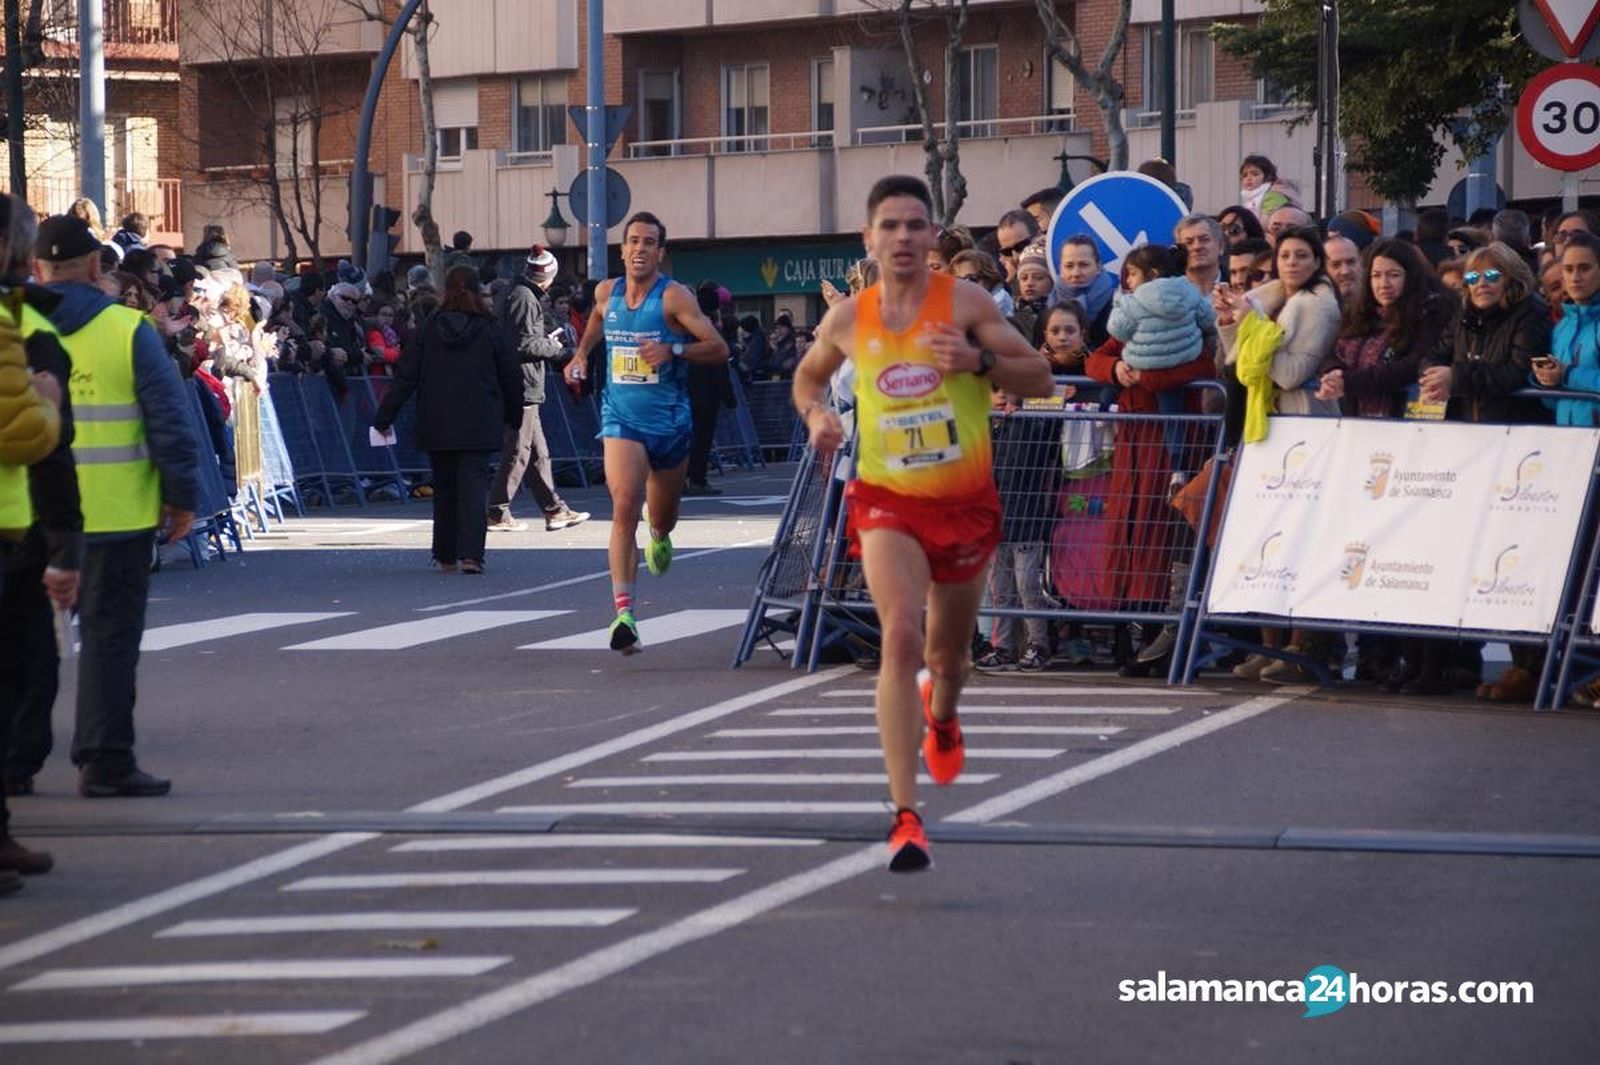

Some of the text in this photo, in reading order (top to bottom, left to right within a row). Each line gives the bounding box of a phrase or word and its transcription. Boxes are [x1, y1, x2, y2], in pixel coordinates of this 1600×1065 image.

[1542, 101, 1600, 134] 30
[783, 258, 816, 287] CAJA
[904, 427, 924, 448] 71
